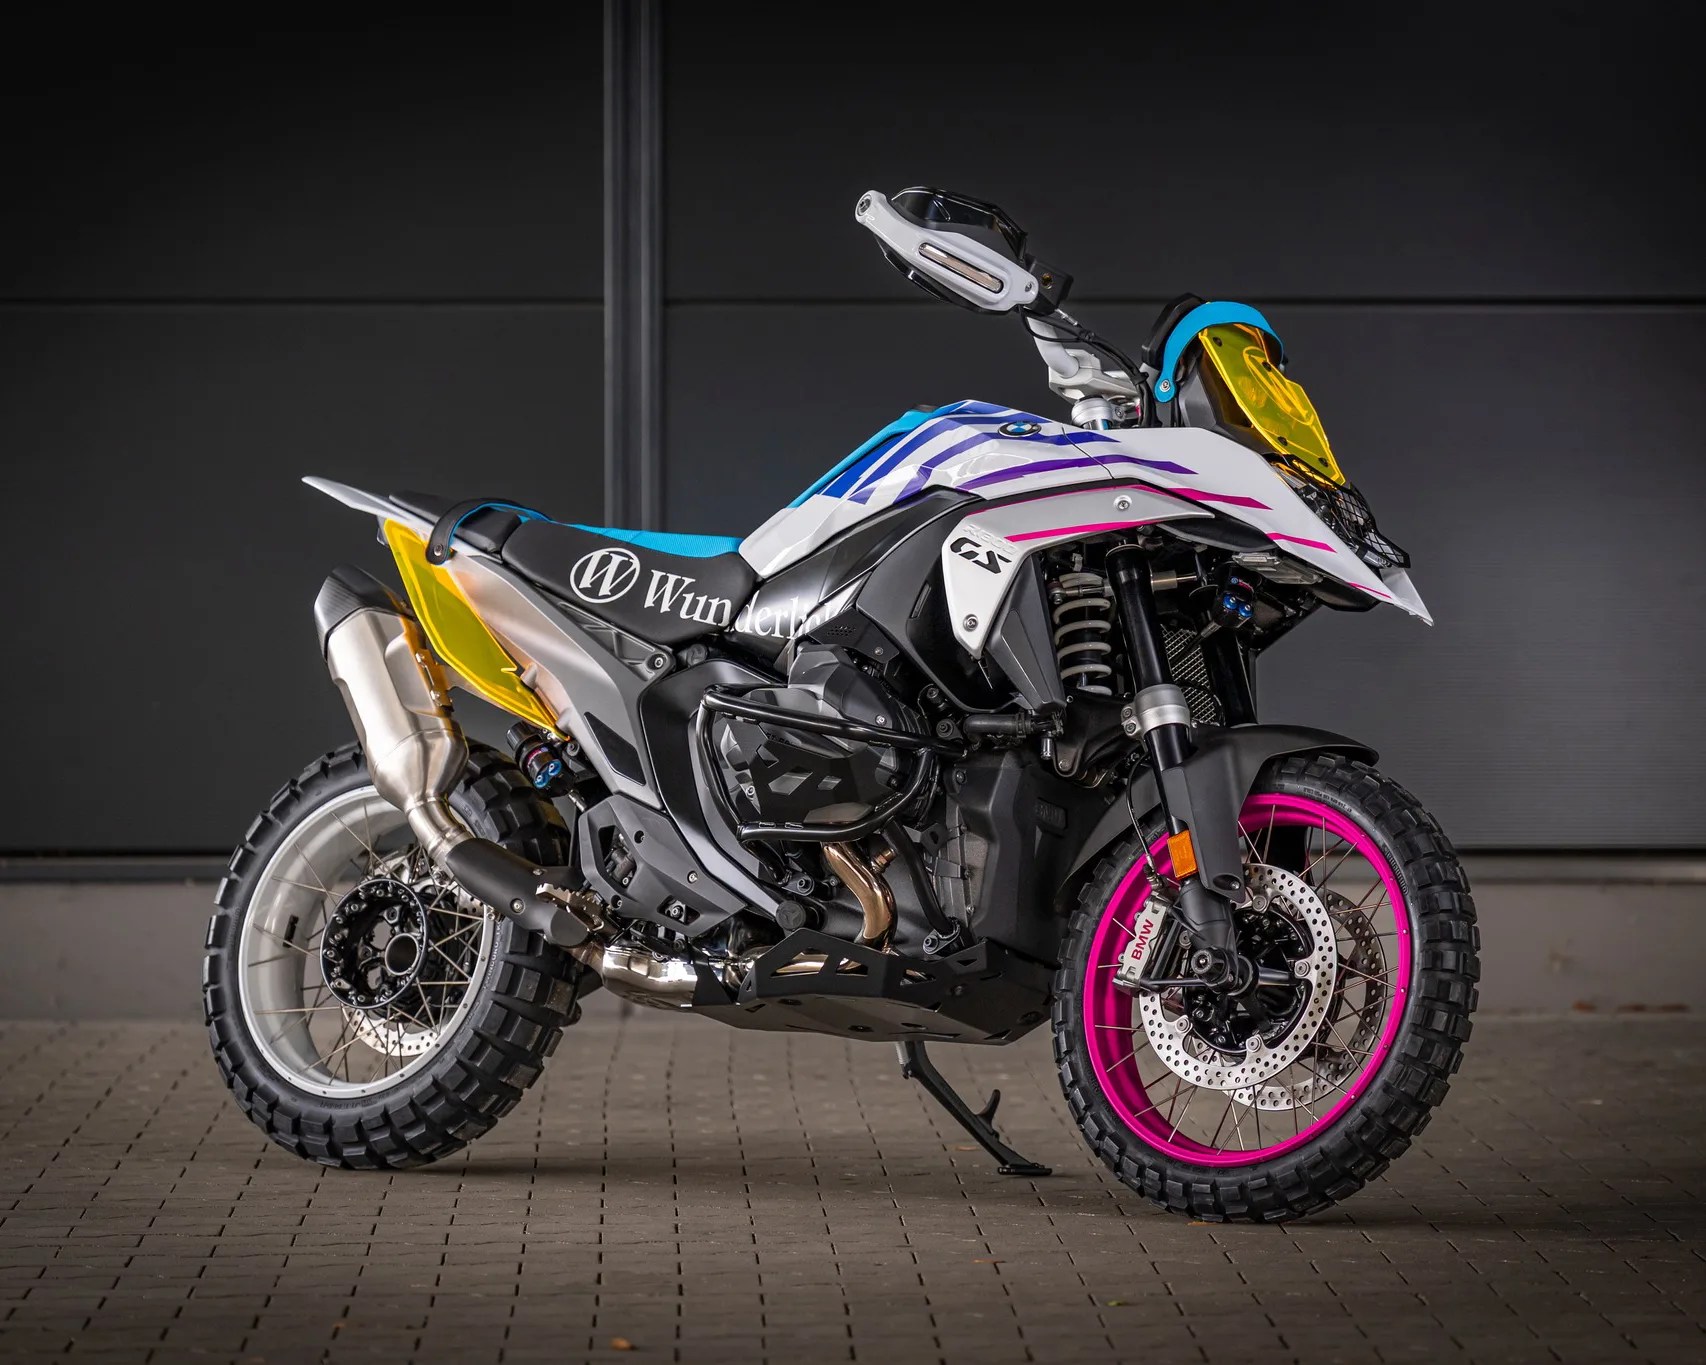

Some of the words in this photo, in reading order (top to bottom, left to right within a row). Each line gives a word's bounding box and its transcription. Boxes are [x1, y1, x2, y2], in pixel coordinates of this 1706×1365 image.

[575, 549, 639, 599] W
[950, 537, 1012, 574] GS
[1132, 918, 1154, 960] BMW
